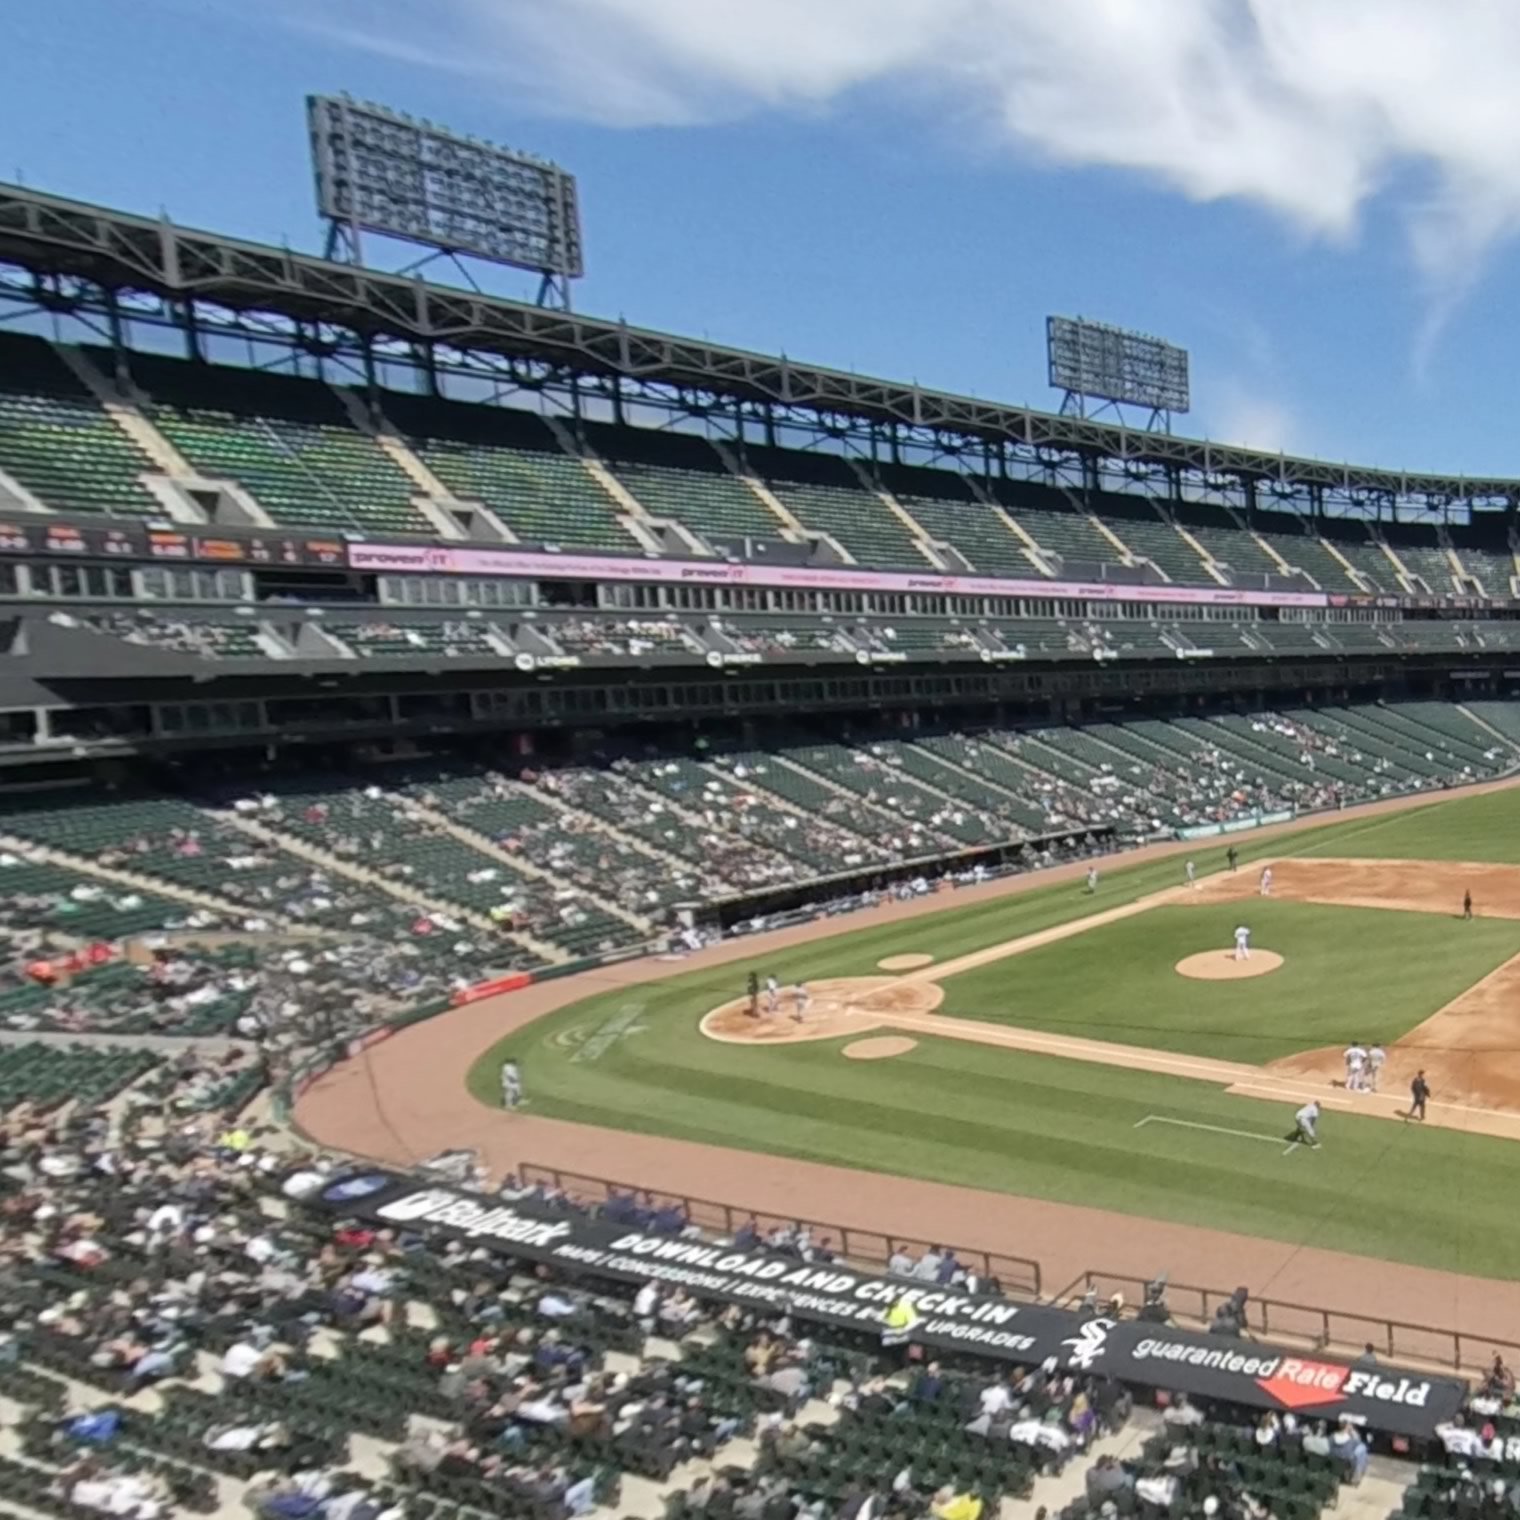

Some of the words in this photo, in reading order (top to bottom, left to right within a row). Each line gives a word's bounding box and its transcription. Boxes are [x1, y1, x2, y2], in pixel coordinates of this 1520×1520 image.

[422, 1200, 571, 1246] Ballpark
[609, 1233, 788, 1279] DOWNLOAD
[780, 1267, 856, 1294] AND
[607, 1255, 729, 1290] CONCESSIONS
[925, 1319, 1036, 1351] UPGRADES
[1132, 1336, 1280, 1378] guaranteed
[1278, 1358, 1341, 1390] Rate
[1341, 1370, 1432, 1407] Field
